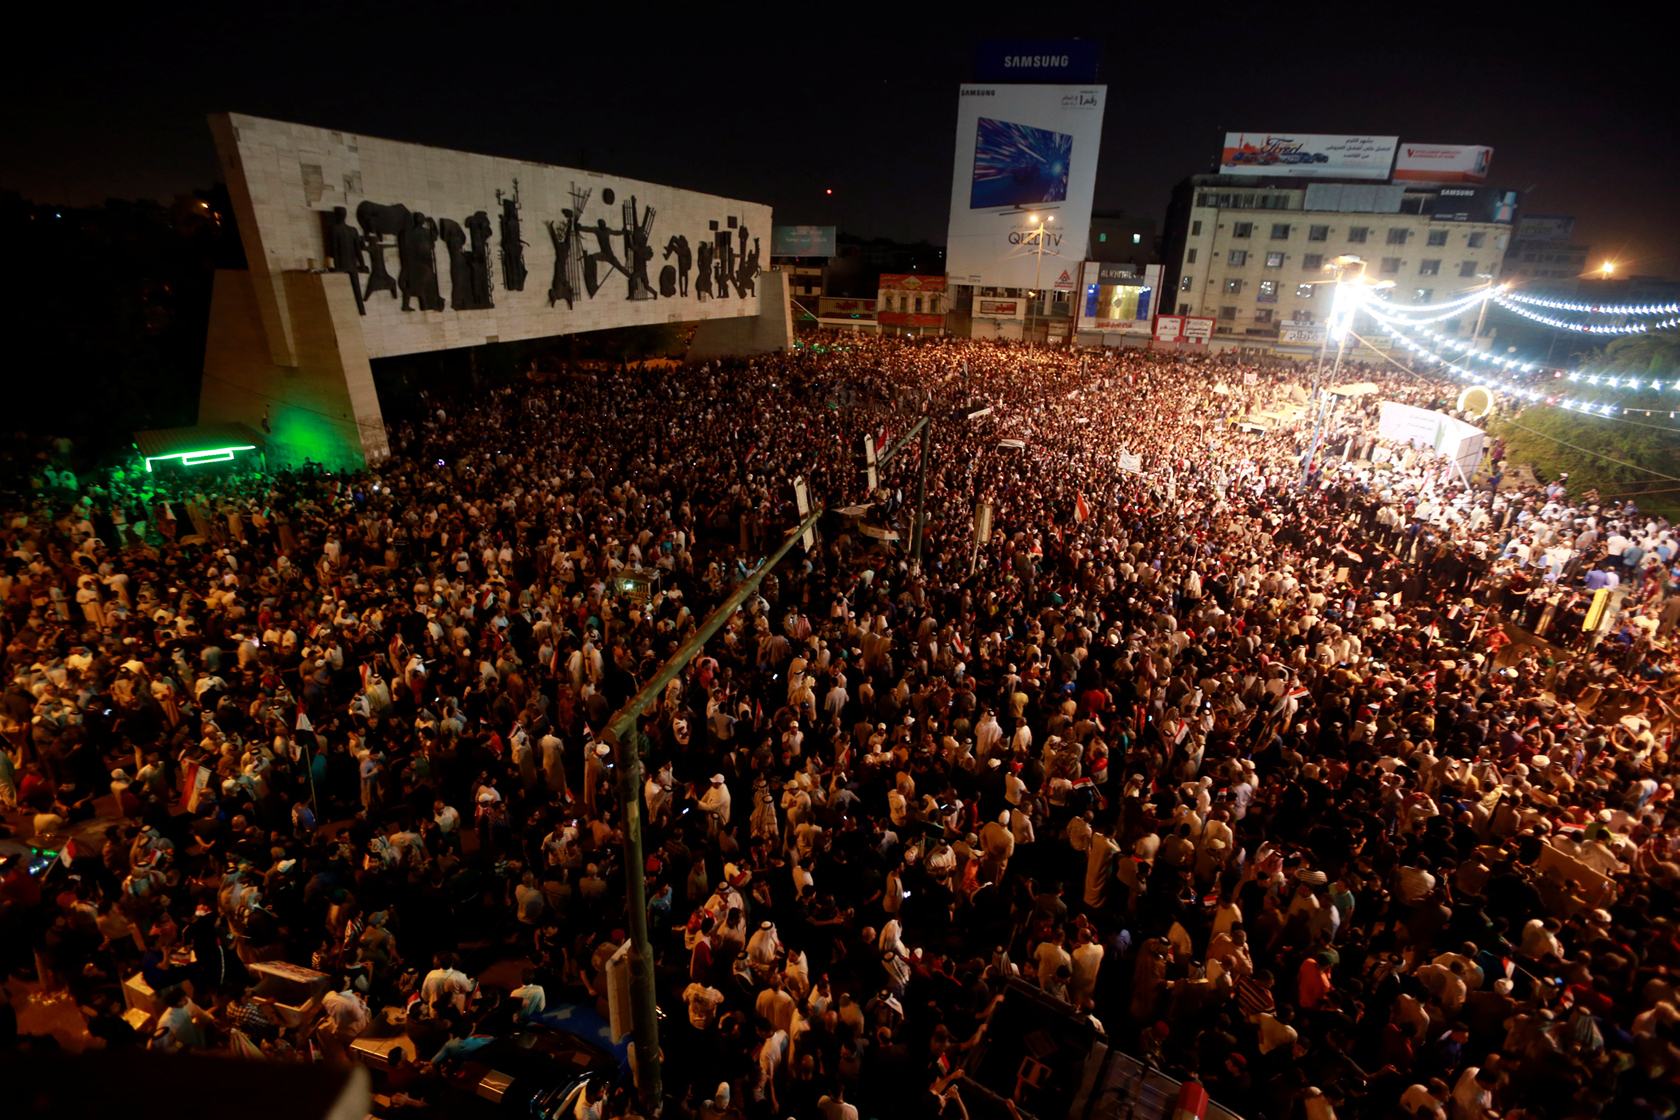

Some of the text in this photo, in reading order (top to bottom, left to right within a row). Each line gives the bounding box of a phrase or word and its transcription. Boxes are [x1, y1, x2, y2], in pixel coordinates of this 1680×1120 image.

[1004, 55, 1069, 68] SAMSUNG
[1261, 137, 1304, 155] Ford
[1008, 231, 1063, 247] QLED TV
